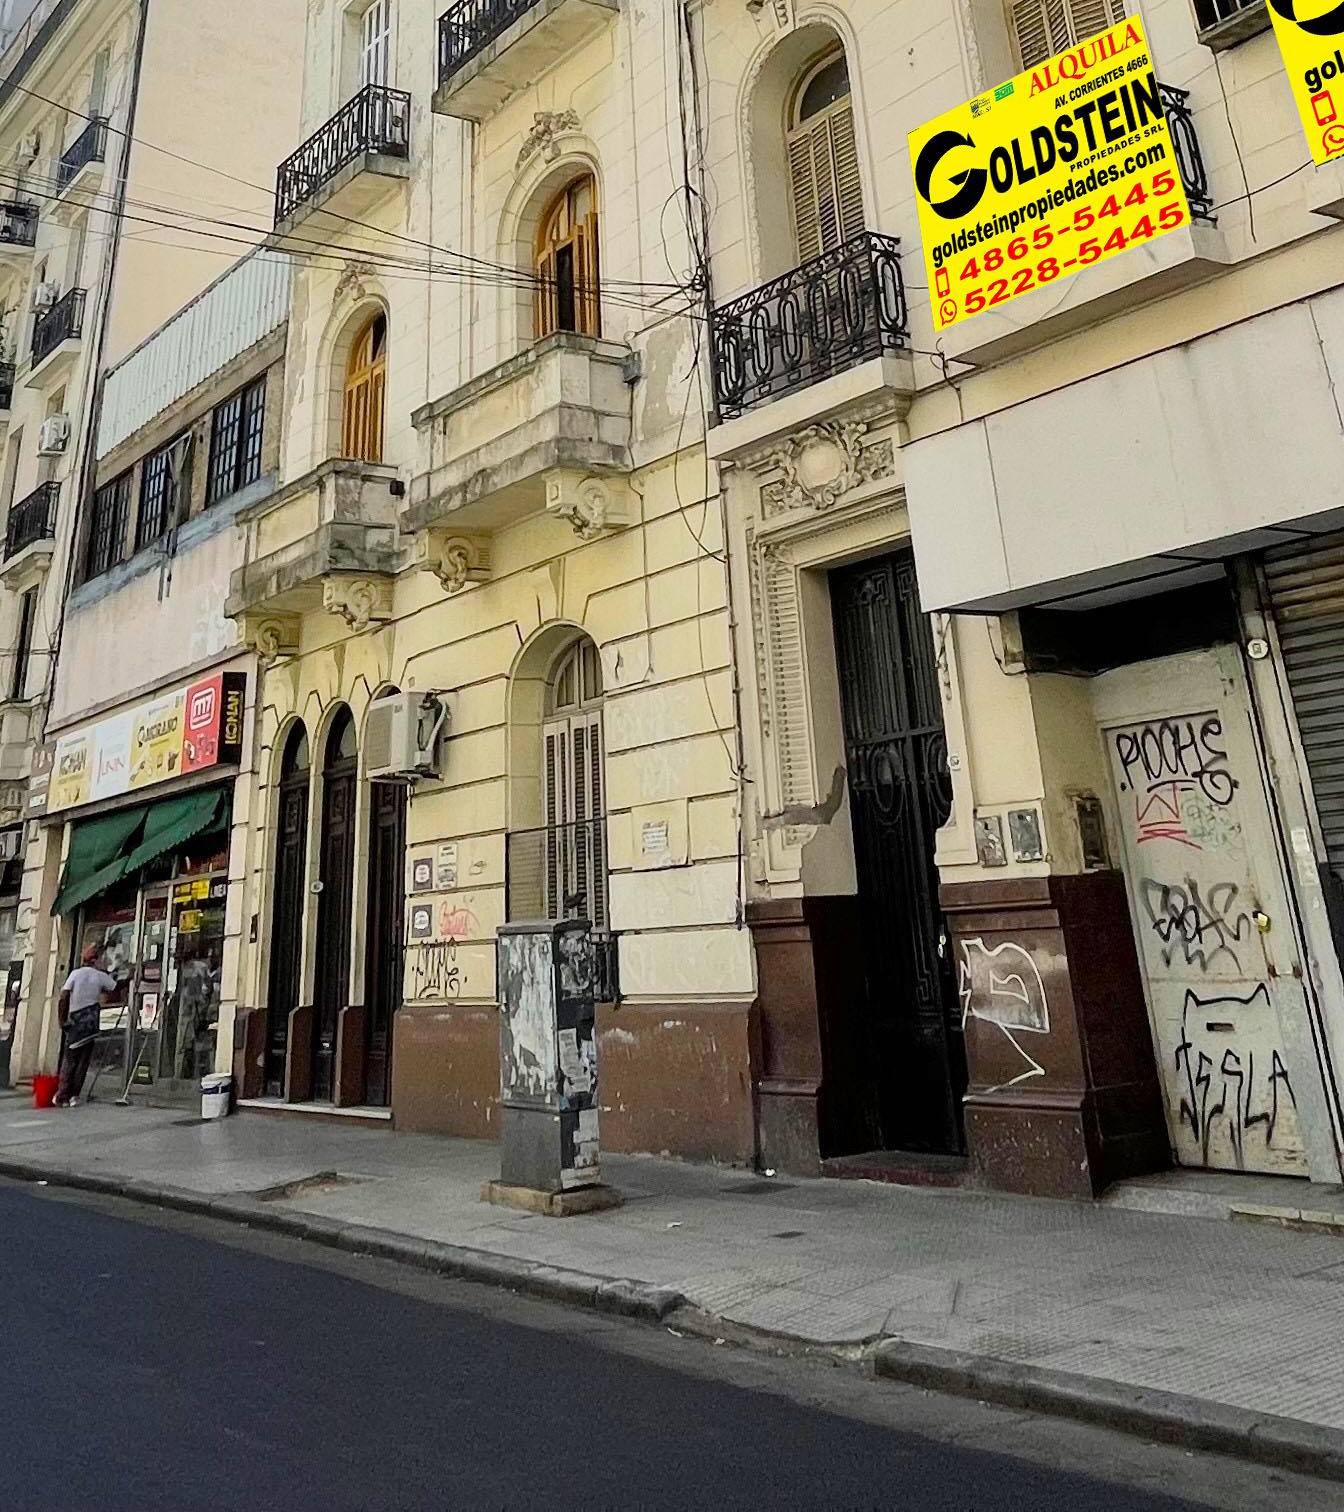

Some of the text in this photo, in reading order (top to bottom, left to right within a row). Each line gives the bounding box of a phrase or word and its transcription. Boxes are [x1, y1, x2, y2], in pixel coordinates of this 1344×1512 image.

[1029, 23, 1143, 97] ALQUILA
[1055, 54, 1149, 109] AV. CORRIENTES 4666
[915, 72, 1165, 220] GOLDSTEIN
[1070, 124, 1165, 172] PROPIEDADES SRL
[932, 143, 1166, 268] goldsteinpropiedades.com
[959, 169, 1176, 281] 4865-5445
[964, 202, 1184, 314] 5228-5445
[1174, 1028, 1298, 1170] TESLA
